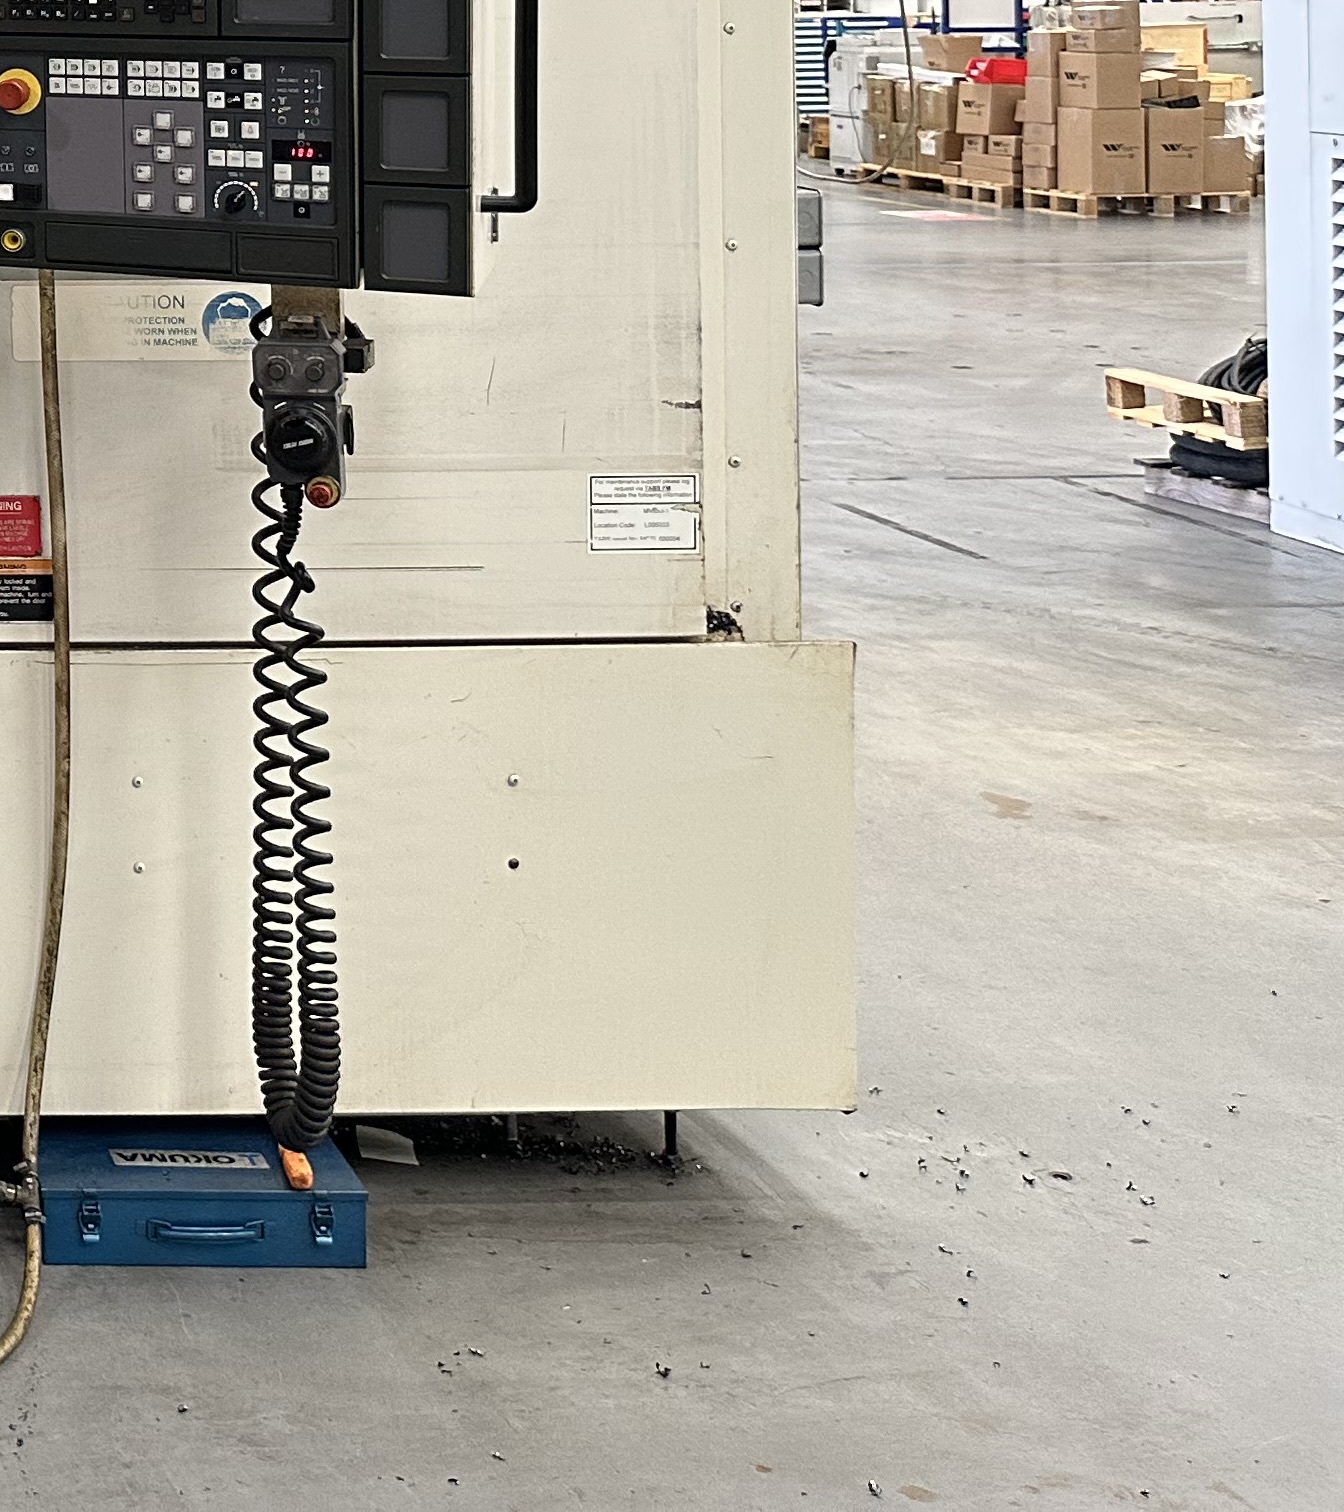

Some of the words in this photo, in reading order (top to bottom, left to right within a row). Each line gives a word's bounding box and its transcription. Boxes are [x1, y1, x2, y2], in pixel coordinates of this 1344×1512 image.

[168, 327, 197, 336] WHEN
[153, 338, 198, 347] MACHINE
[115, 1152, 236, 1165] OKUMA
